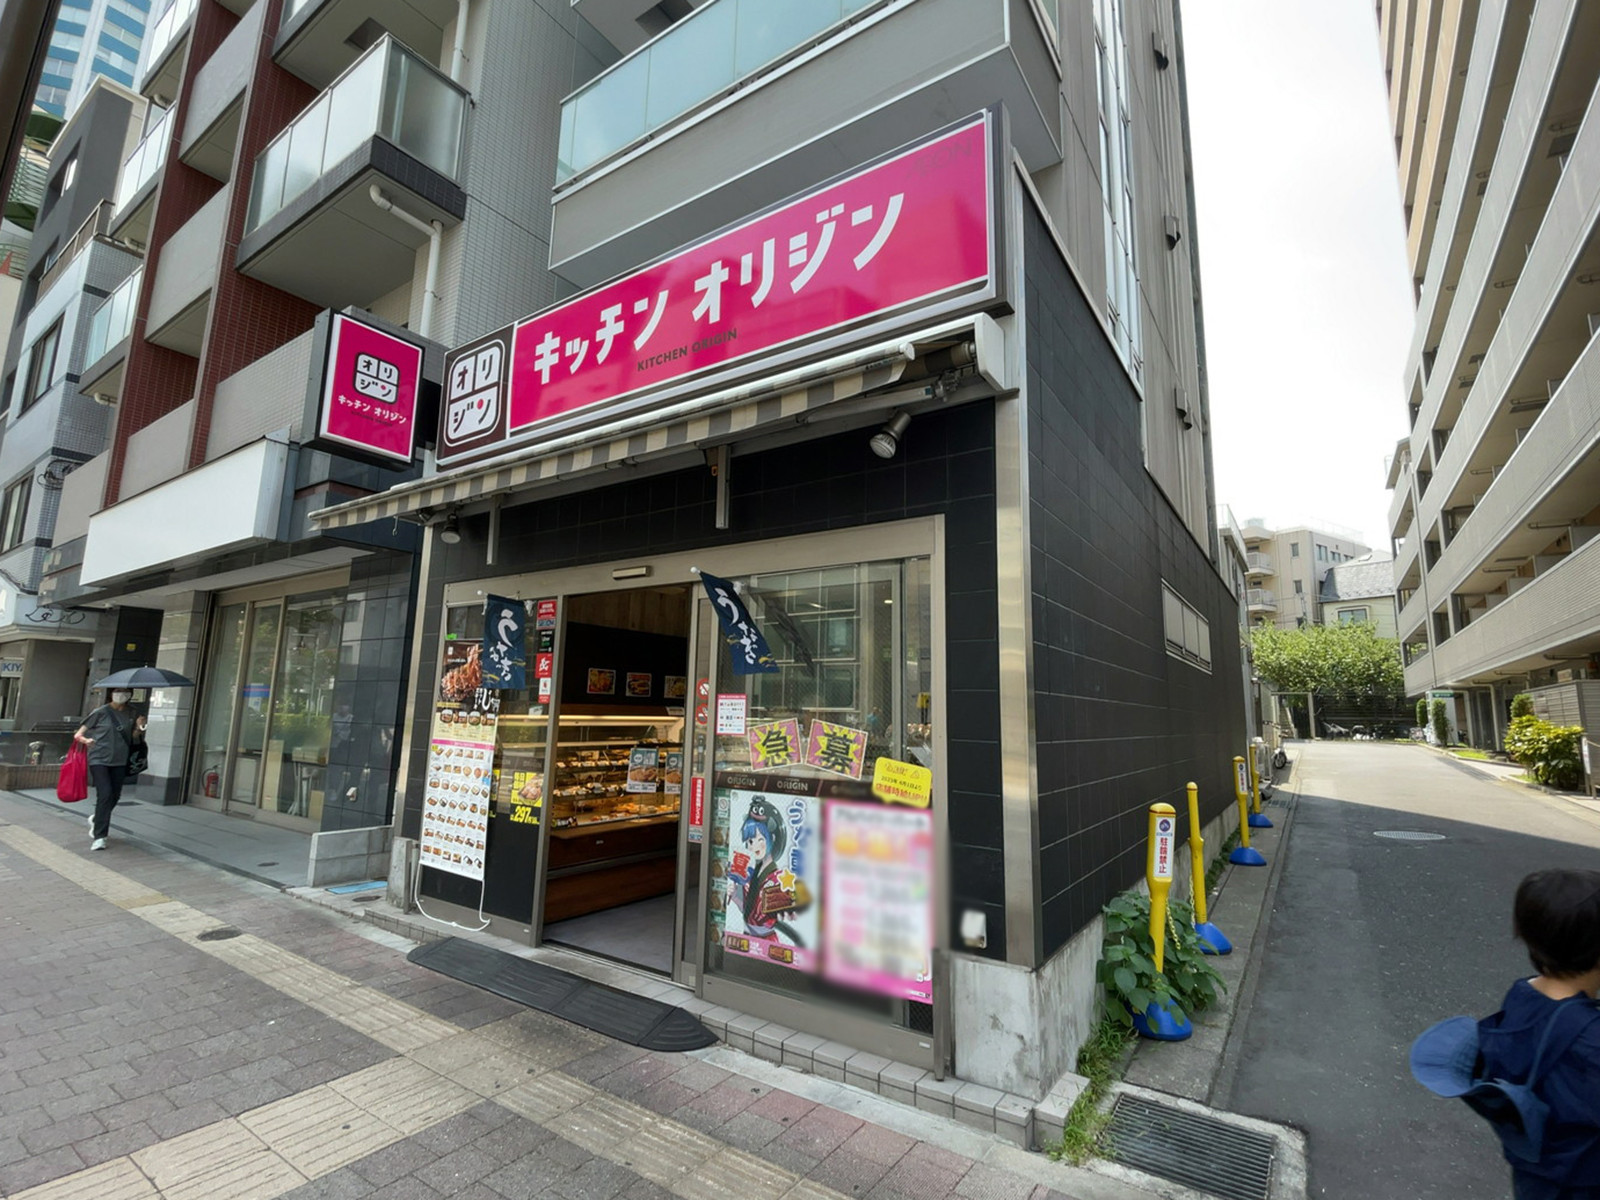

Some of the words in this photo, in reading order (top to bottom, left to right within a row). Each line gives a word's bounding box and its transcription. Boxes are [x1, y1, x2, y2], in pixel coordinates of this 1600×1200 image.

[533, 289, 669, 385] キッチン
[691, 192, 905, 325] オリジン
[637, 345, 689, 372] KITCHEN
[691, 327, 738, 352] ORIGIN
[456, 353, 494, 391] オリ
[337, 394, 371, 412] キッチン
[374, 407, 407, 424] オリジン
[714, 587, 758, 665] うなぎ
[2, 662, 23, 672] KIY
[761, 729, 790, 768] 急
[819, 731, 855, 774] 募
[776, 780, 809, 791] ORIGIN
